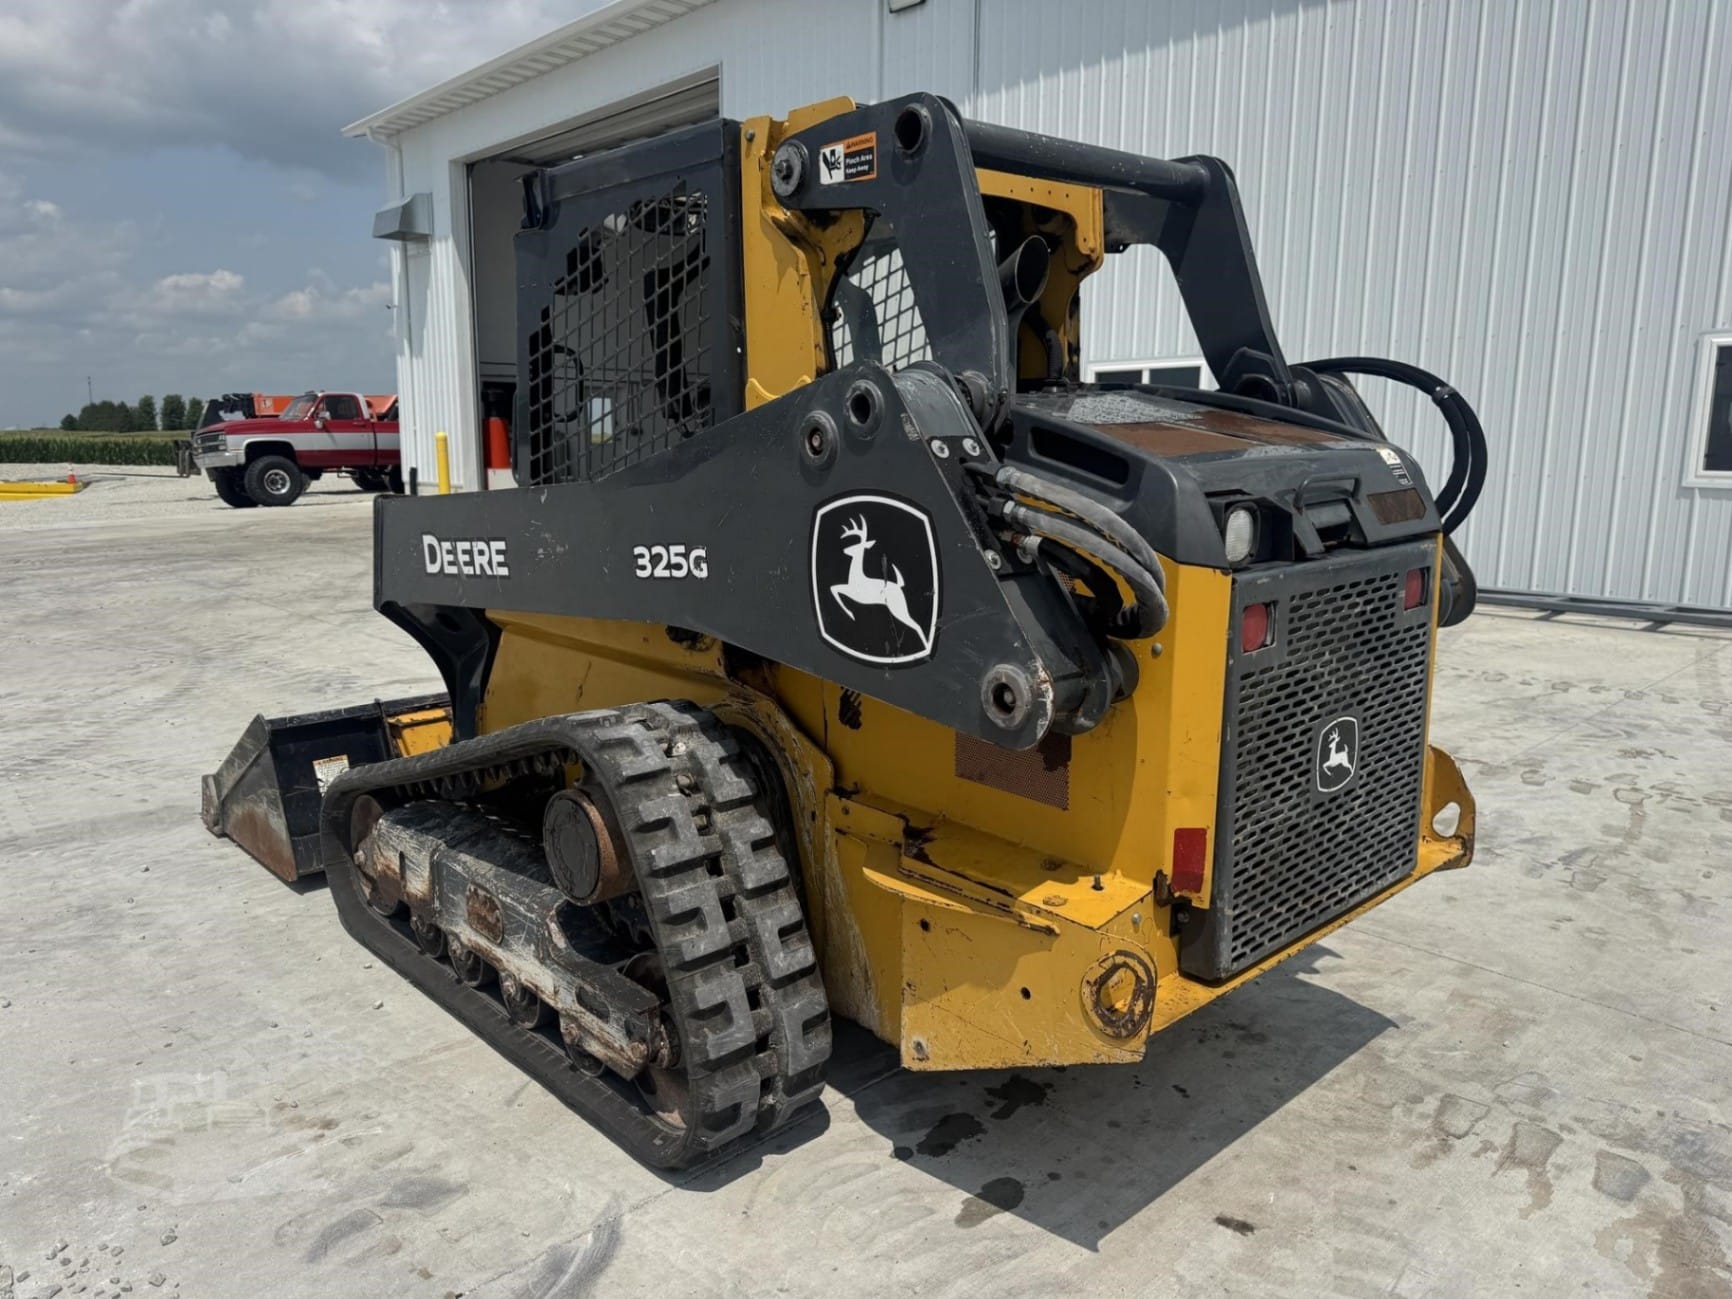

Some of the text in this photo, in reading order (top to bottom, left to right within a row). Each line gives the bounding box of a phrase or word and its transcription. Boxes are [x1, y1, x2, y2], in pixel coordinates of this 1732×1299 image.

[846, 156, 860, 164] Pinch
[422, 534, 510, 577] DEERE
[633, 545, 709, 578] 325G
